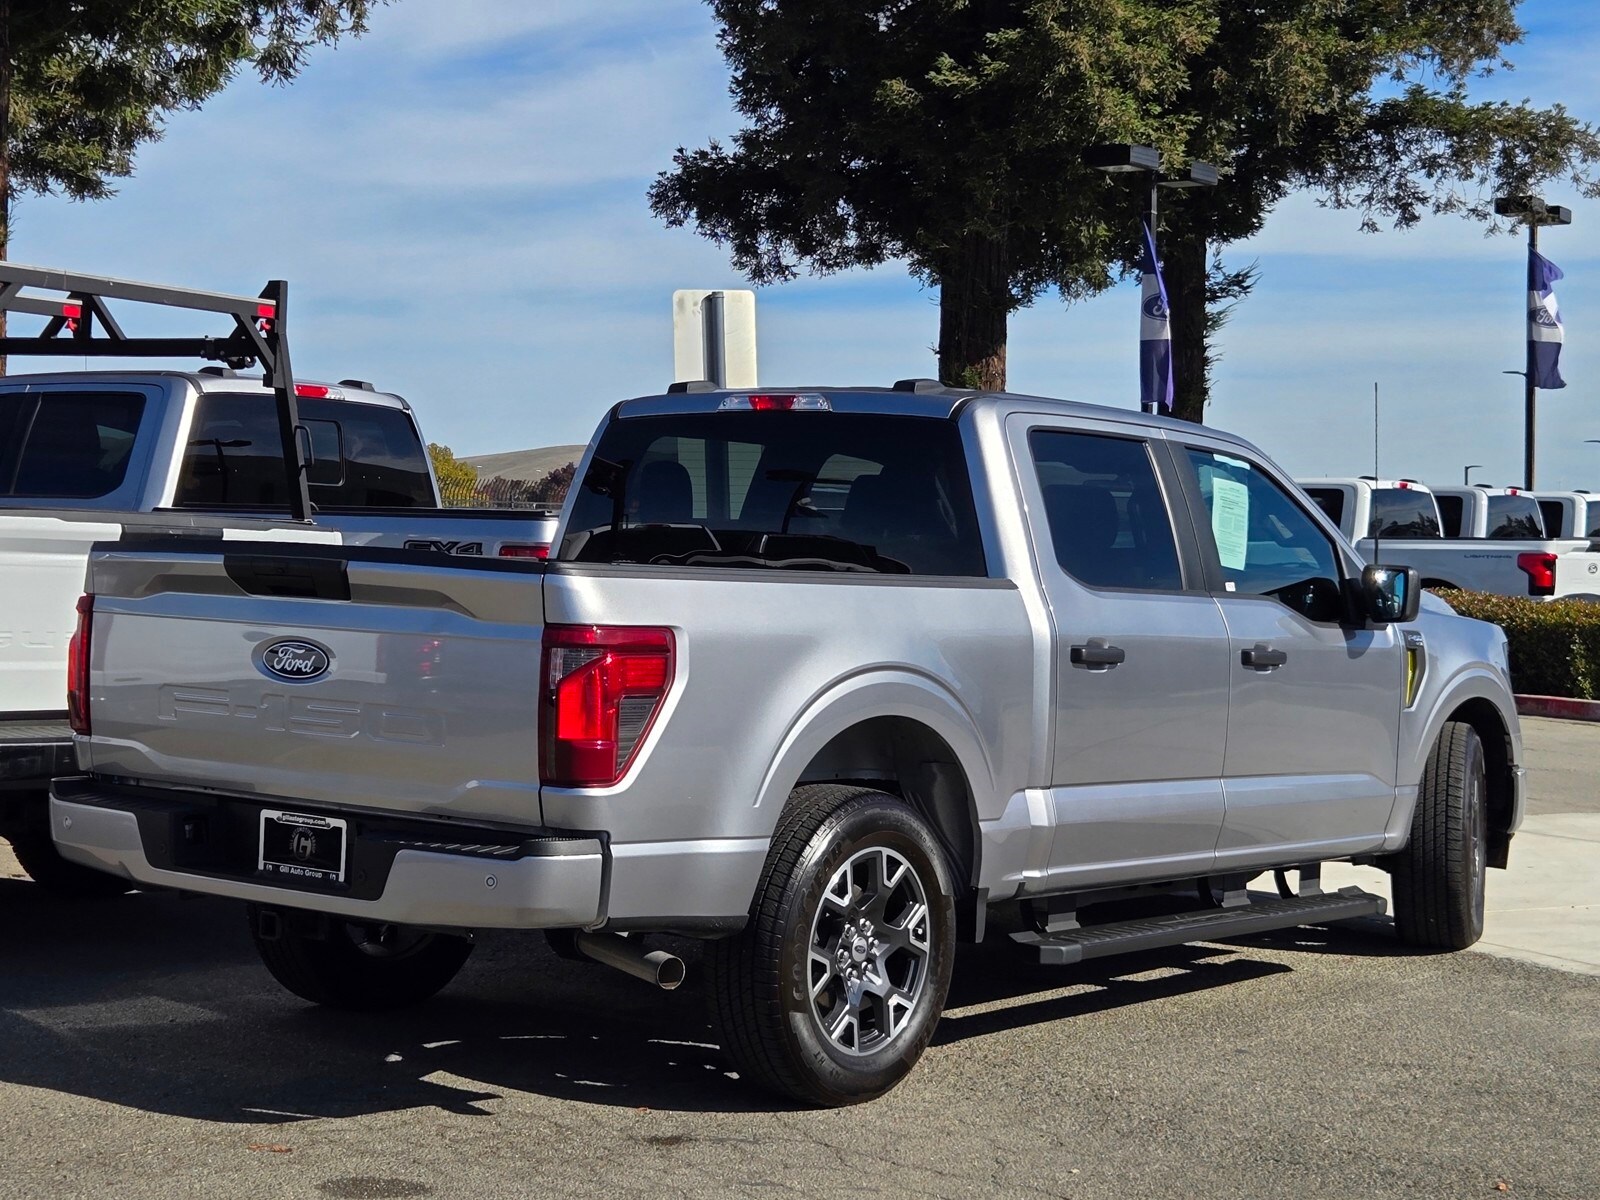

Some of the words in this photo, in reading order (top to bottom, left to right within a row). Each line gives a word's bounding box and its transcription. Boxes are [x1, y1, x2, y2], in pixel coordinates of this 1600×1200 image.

[273, 646, 316, 673] Ford
[158, 683, 447, 748] F-150
[279, 865, 290, 874] Gill
[290, 867, 304, 876] Auto
[304, 869, 323, 879] Group
